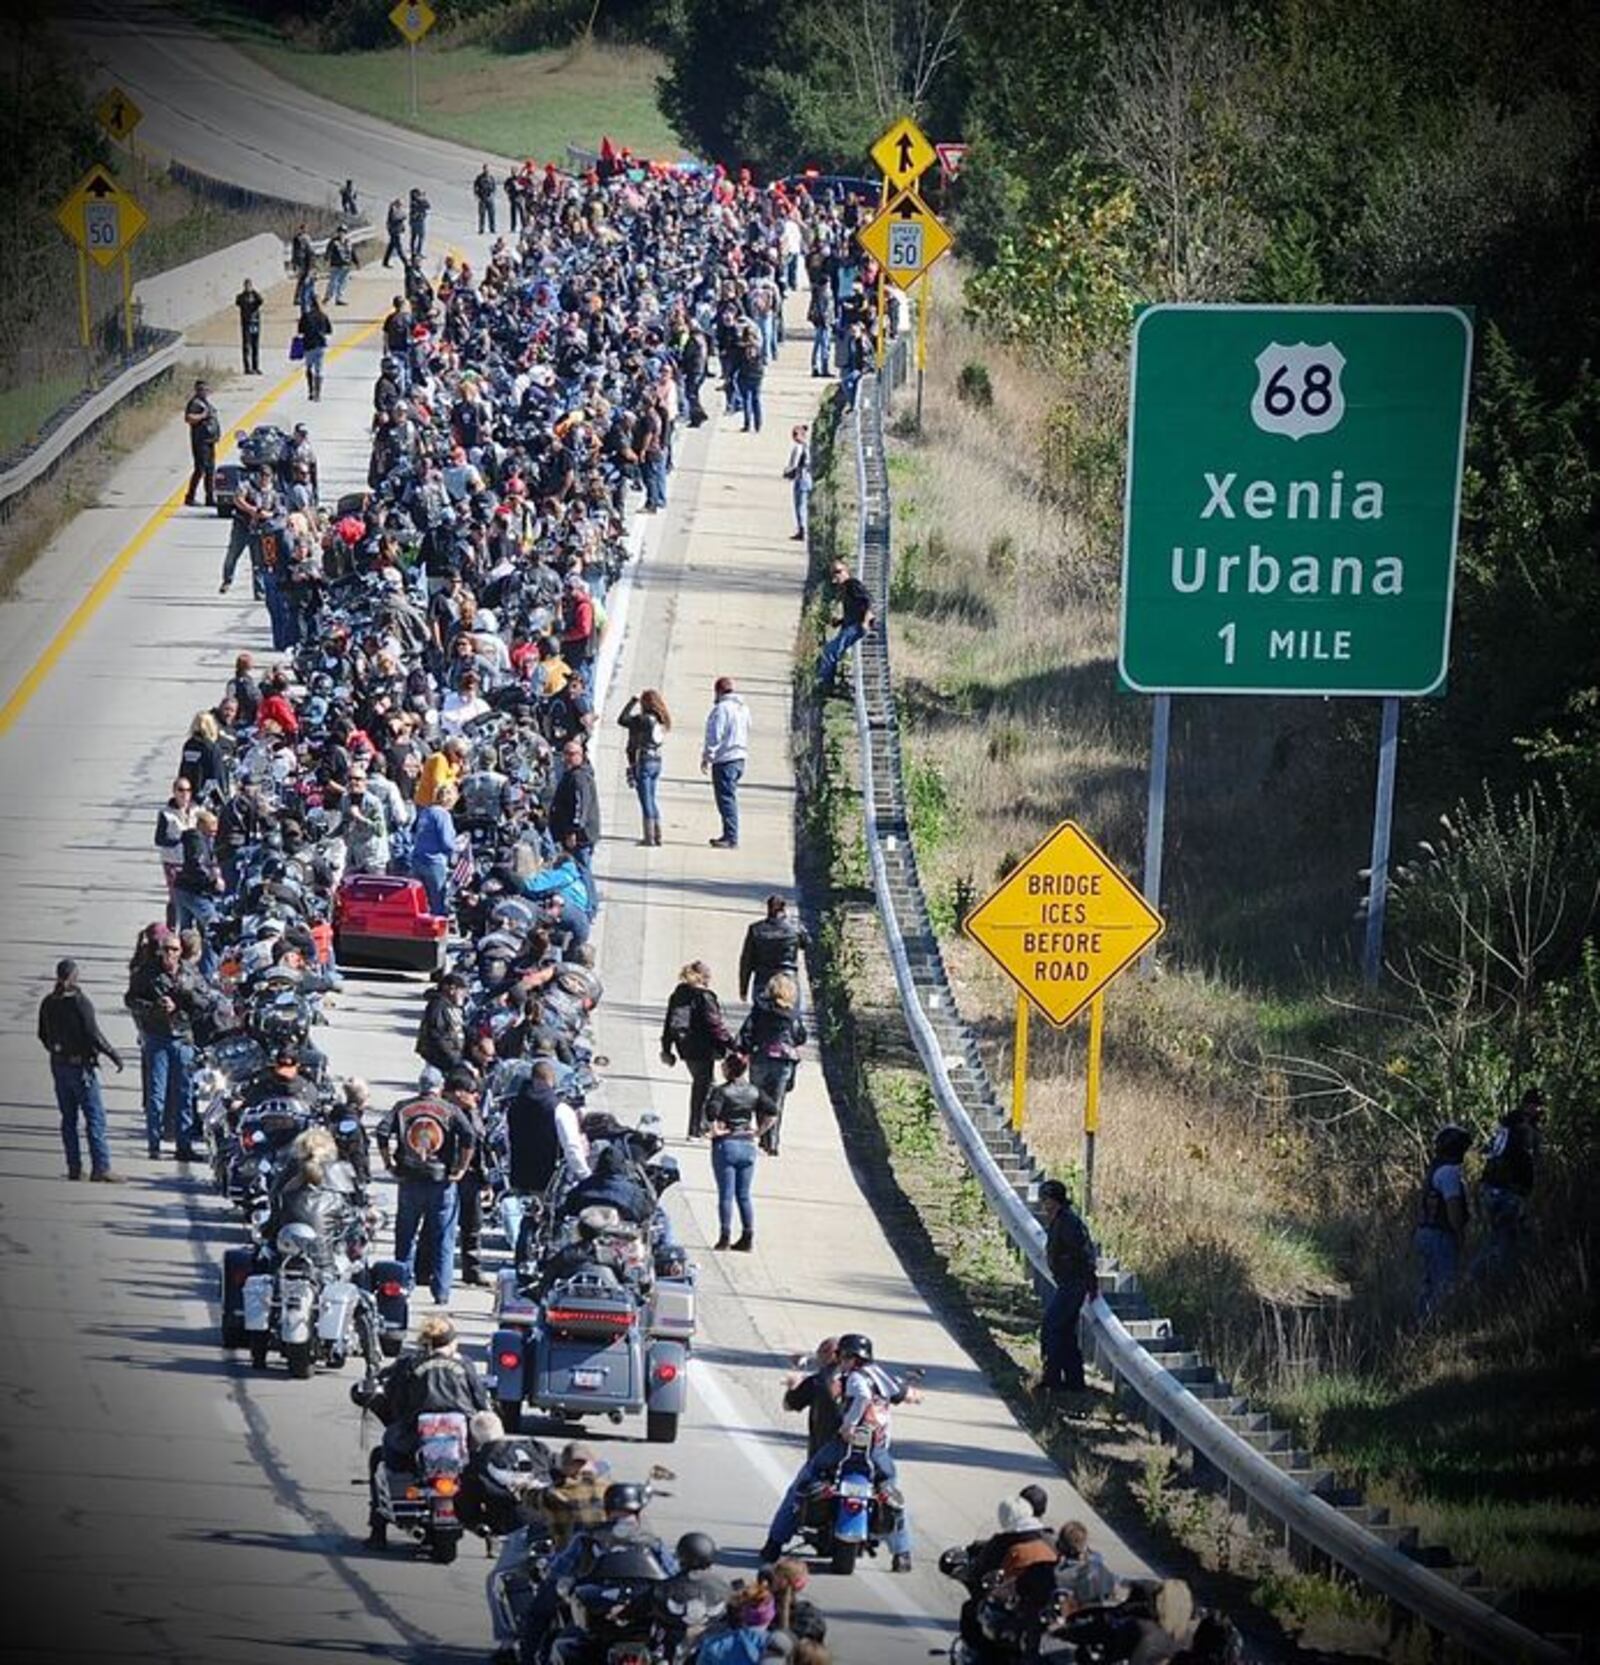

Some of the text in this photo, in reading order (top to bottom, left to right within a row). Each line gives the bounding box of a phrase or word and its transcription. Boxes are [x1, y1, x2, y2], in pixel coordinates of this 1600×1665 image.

[90, 222, 115, 244] 50
[893, 244, 917, 265] 50
[1264, 364, 1333, 417] 68
[1200, 470, 1385, 520] Xenia
[1171, 545, 1404, 596] Urbana
[1217, 622, 1352, 665] 1 MILE
[1028, 875, 1103, 896] BRIDGE
[1041, 904, 1086, 924] ICES
[1024, 932, 1103, 954] BEFORE
[1035, 961, 1090, 982] ROAD
